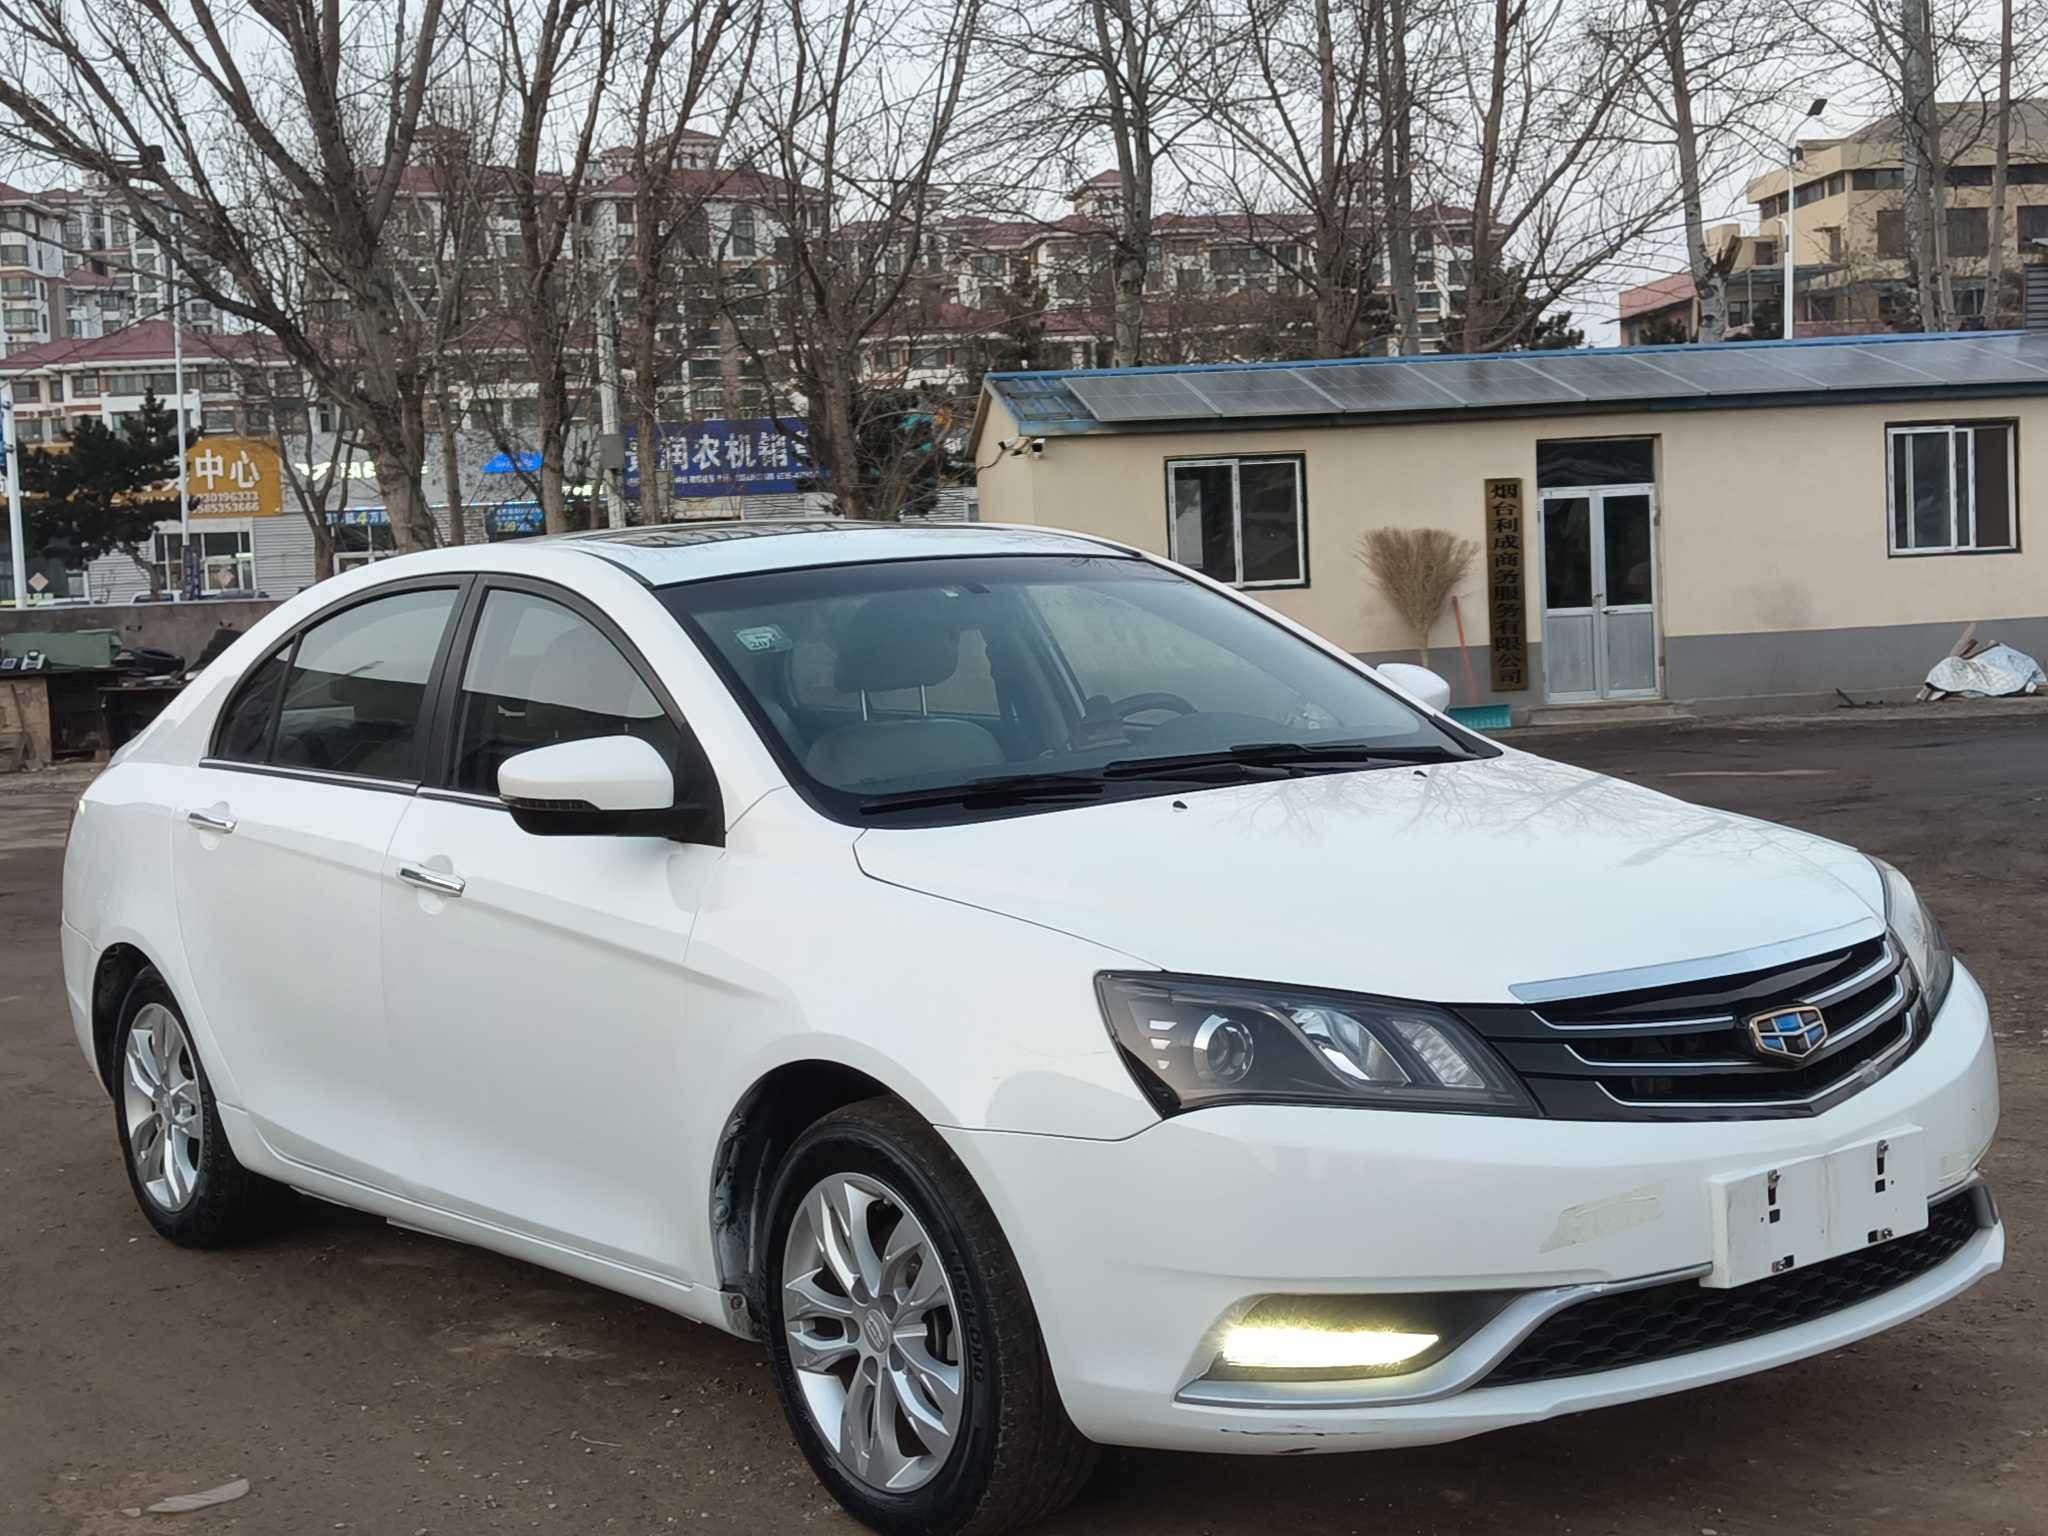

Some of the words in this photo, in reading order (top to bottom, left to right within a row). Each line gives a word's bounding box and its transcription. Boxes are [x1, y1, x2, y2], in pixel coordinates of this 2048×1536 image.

[1491, 484, 1521, 684] 烟台利成商务服务有限公司
